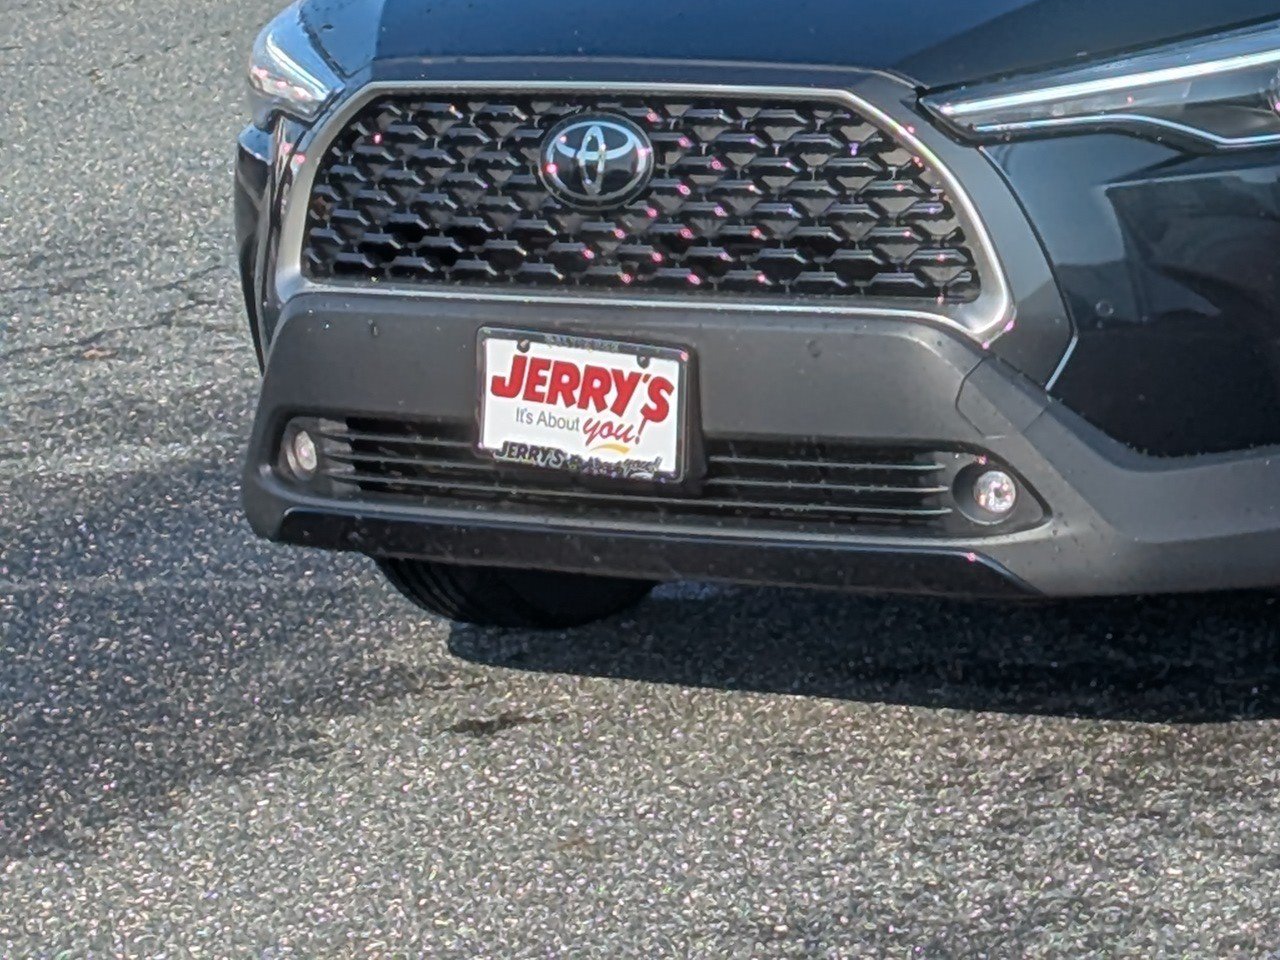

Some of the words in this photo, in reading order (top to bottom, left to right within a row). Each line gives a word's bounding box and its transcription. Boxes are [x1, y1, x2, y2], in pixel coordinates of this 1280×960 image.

[491, 355, 675, 422] JERRY'S
[516, 407, 534, 425] It's
[536, 411, 580, 431] About
[583, 417, 647, 446] you!
